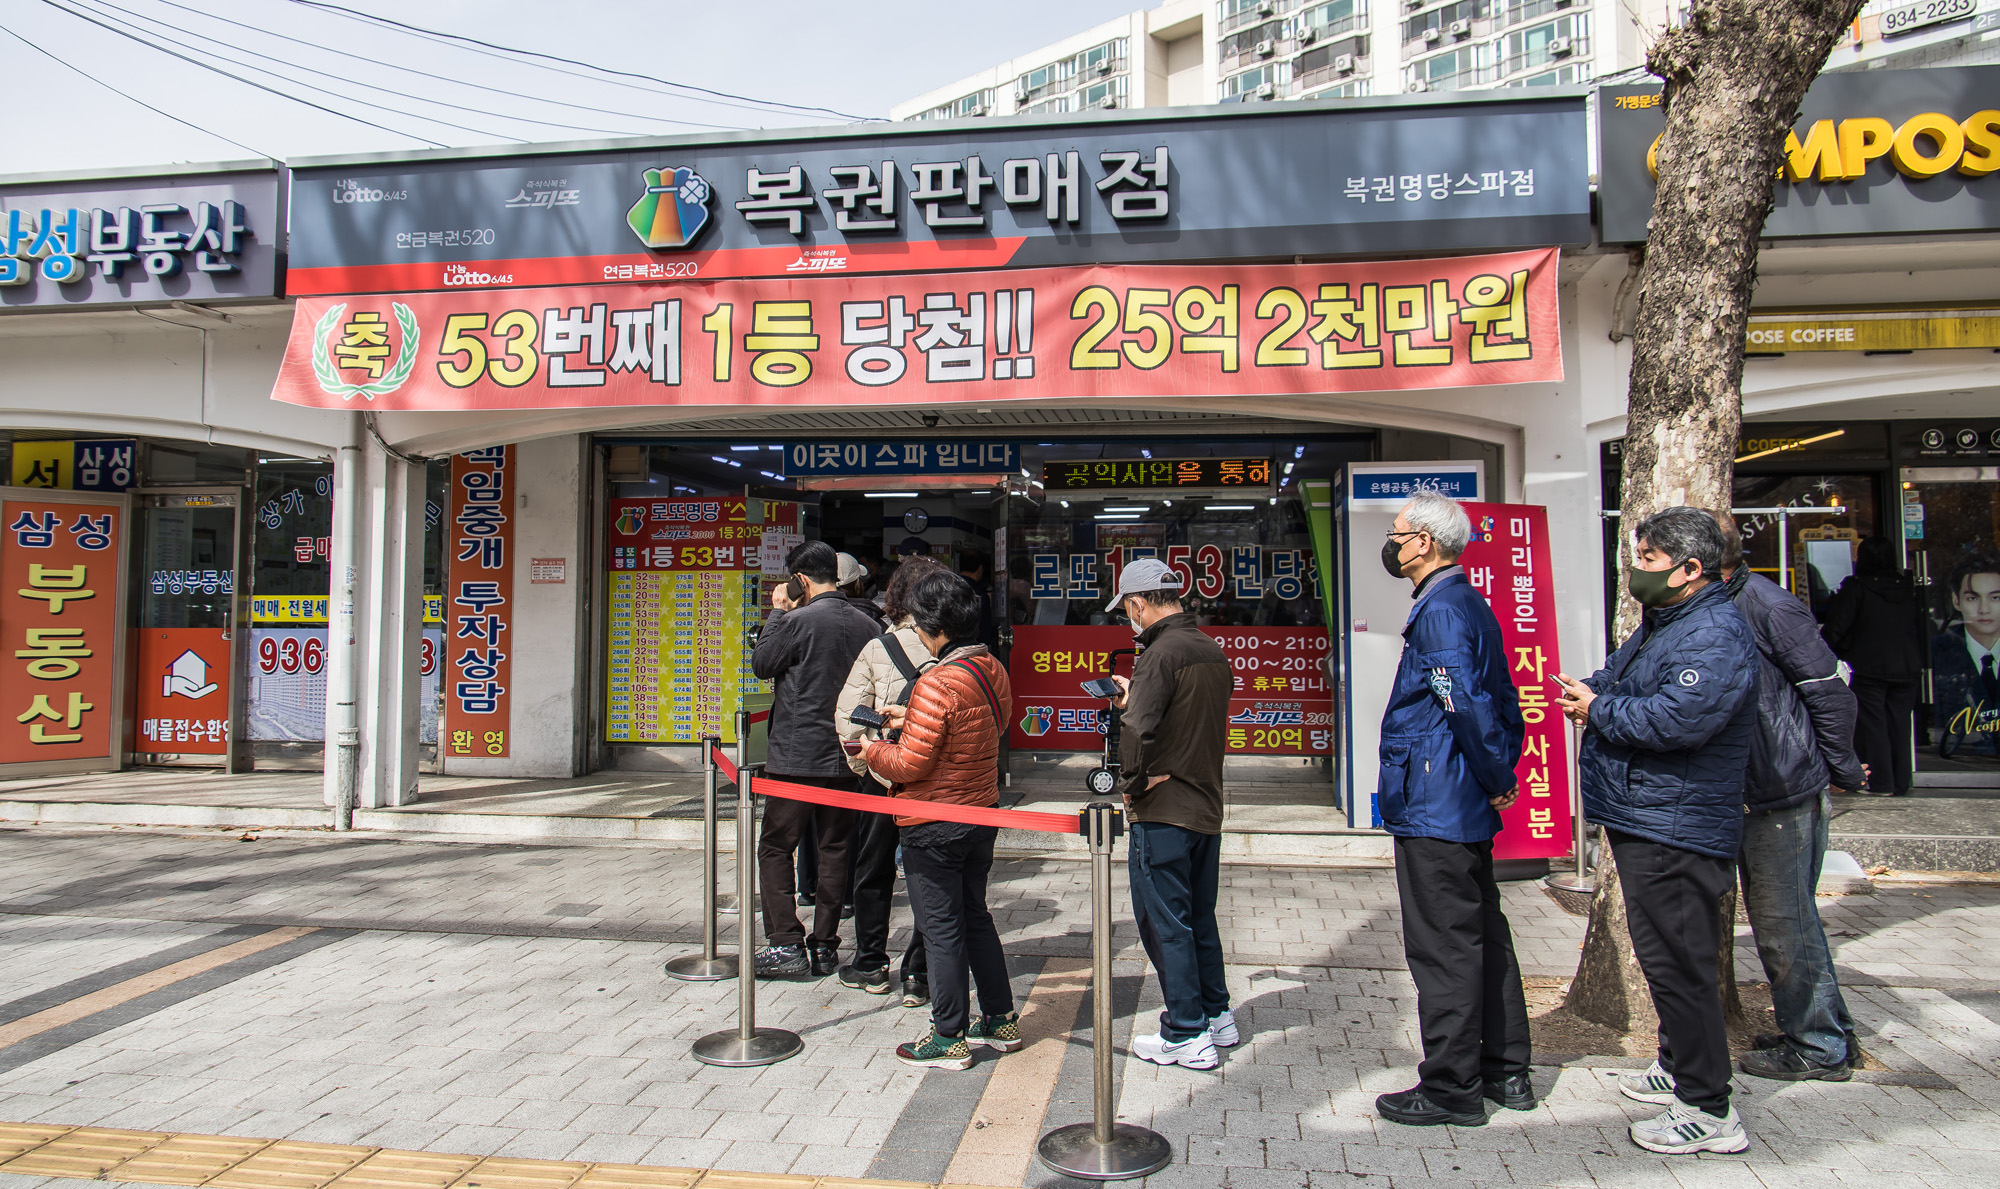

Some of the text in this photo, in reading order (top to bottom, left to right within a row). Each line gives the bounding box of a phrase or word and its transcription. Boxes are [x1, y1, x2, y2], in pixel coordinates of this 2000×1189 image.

[1885, 0, 1970, 29] 934-2233
[1976, 13, 1997, 28] 2F
[1647, 110, 2000, 182] MPOS
[337, 179, 358, 189] 나눔
[735, 146, 1169, 234] 복권판매점
[1343, 169, 1535, 203] 복권명당스파점
[504, 188, 580, 209] 스피또
[0, 200, 250, 286] 삼성부동산
[396, 228, 495, 249] 연금복권520
[447, 264, 467, 274] 나눔
[603, 261, 698, 280] 연금복권520
[786, 256, 847, 272] 스피또
[334, 267, 1533, 389] 축 53번째 1등 당첨!! 25억 2천만원
[1791, 328, 1855, 343] COFFEE
[78, 446, 133, 486] 삼성
[793, 444, 1013, 469] 이곳이 스파 입니다
[1065, 461, 1202, 486] 공익사업을
[260, 488, 304, 530] 상가
[651, 502, 720, 522] 로또명당
[10, 511, 113, 551] 삼성
[651, 529, 691, 541] 스피또
[718, 526, 735, 540] 1등
[737, 525, 762, 540] 20억
[1469, 532, 1492, 542] otto
[641, 546, 734, 568] 1등 53번
[150, 569, 234, 595] 삼성부동산
[1510, 517, 1538, 633] 미리뽑은
[15, 563, 95, 745] 부동산
[258, 636, 329, 675] 936
[454, 581, 507, 714] 투자상담
[1285, 637, 1333, 650] 21:0
[1253, 676, 1332, 691] 휴무입니
[1514, 646, 1549, 724] 자동
[1229, 708, 1304, 727] 스피또
[1253, 729, 1303, 750] 20억
[1310, 730, 1333, 750] 당
